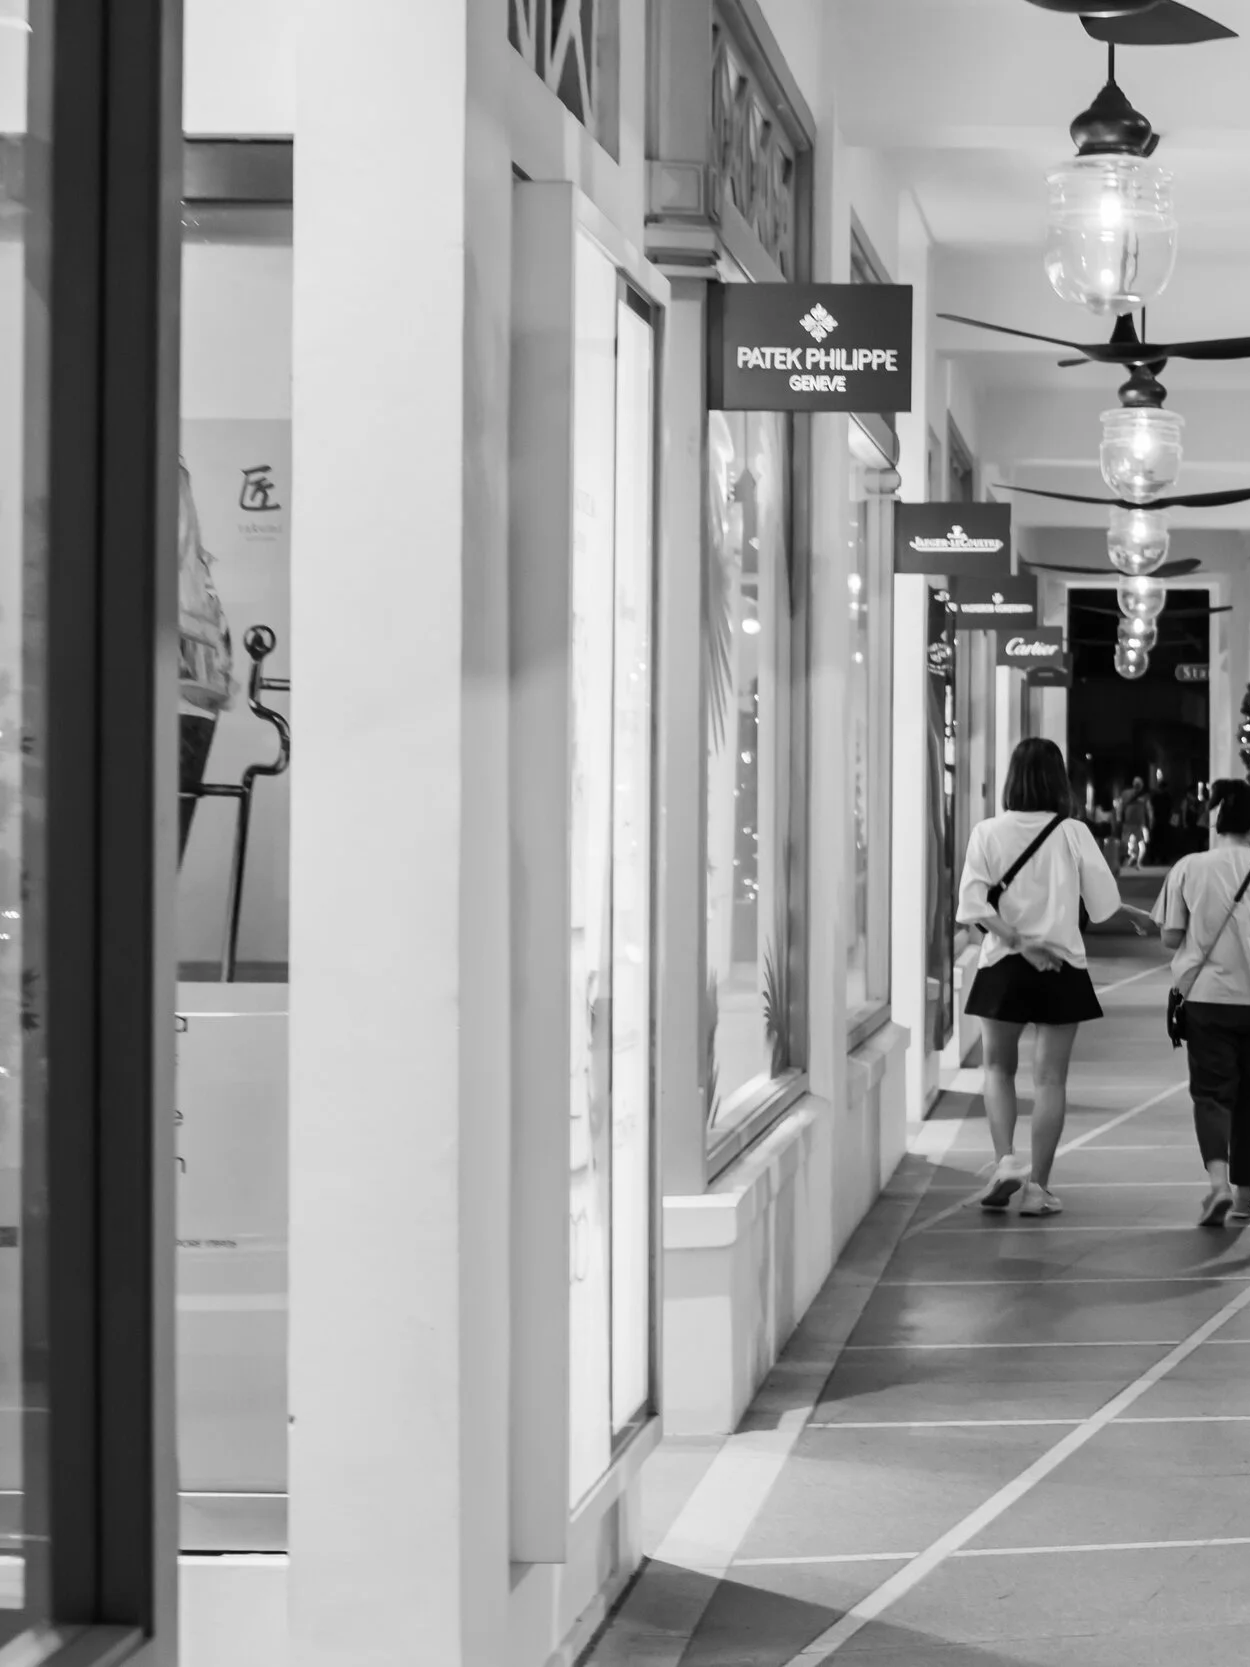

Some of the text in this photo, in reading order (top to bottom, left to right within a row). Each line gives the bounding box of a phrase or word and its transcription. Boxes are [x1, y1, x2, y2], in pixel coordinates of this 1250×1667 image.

[737, 346, 898, 371] PATEK PHILIPPE
[789, 374, 847, 392] GENEVE
[1005, 637, 1059, 656] Cartier
